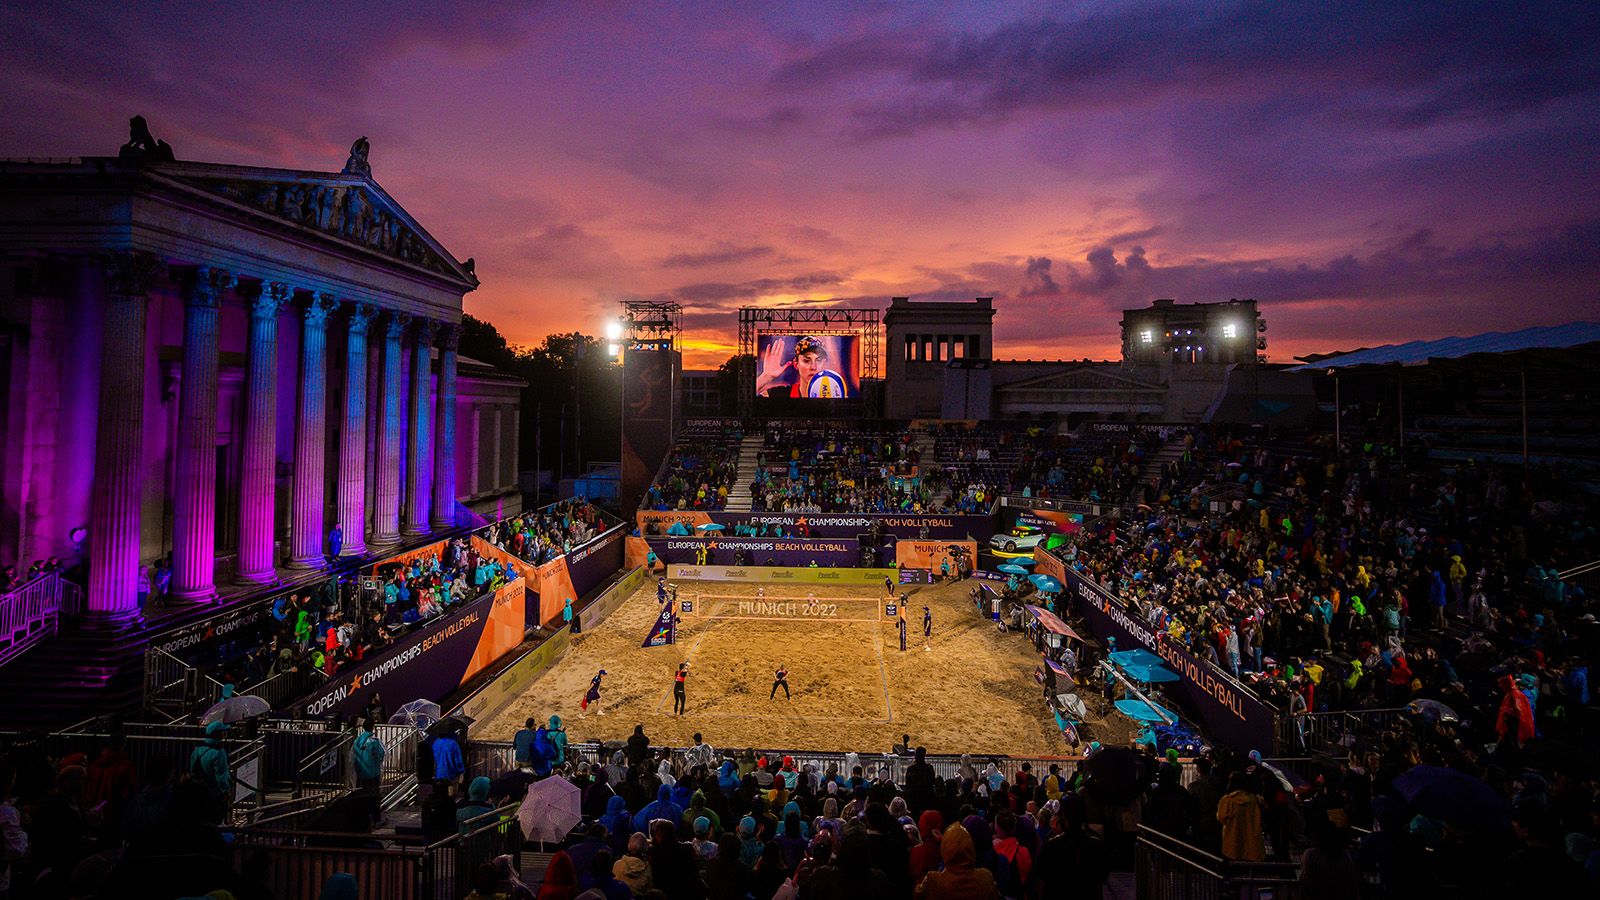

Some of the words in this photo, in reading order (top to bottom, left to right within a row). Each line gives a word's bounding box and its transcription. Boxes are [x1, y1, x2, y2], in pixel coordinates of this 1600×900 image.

[687, 419, 722, 427] EUROPEAN
[808, 517, 870, 527] CHAMPIONSHIPS
[878, 518, 900, 527] EACH
[902, 518, 953, 527] VOLLEYBALL
[667, 541, 706, 550] EUROPEAN
[718, 542, 774, 551] CHAMPIONSHIPS
[775, 543, 800, 551] BEACH
[801, 543, 848, 552] VOLLEYBALL
[914, 545, 948, 553] MUNICH
[738, 601, 797, 616] MUNICH
[801, 603, 838, 617] 2022
[1078, 582, 1103, 611] EUROPEAN
[1110, 606, 1157, 651] CHAMPIONSHIPS
[1157, 639, 1183, 673] BEACH
[1183, 658, 1247, 721] VOLLEYBALL
[306, 684, 347, 715] ROPEAN
[362, 642, 422, 686] CHAMPIONSHIPS
[422, 629, 445, 653] BEACH
[445, 610, 480, 637] VOLLEYBALL
